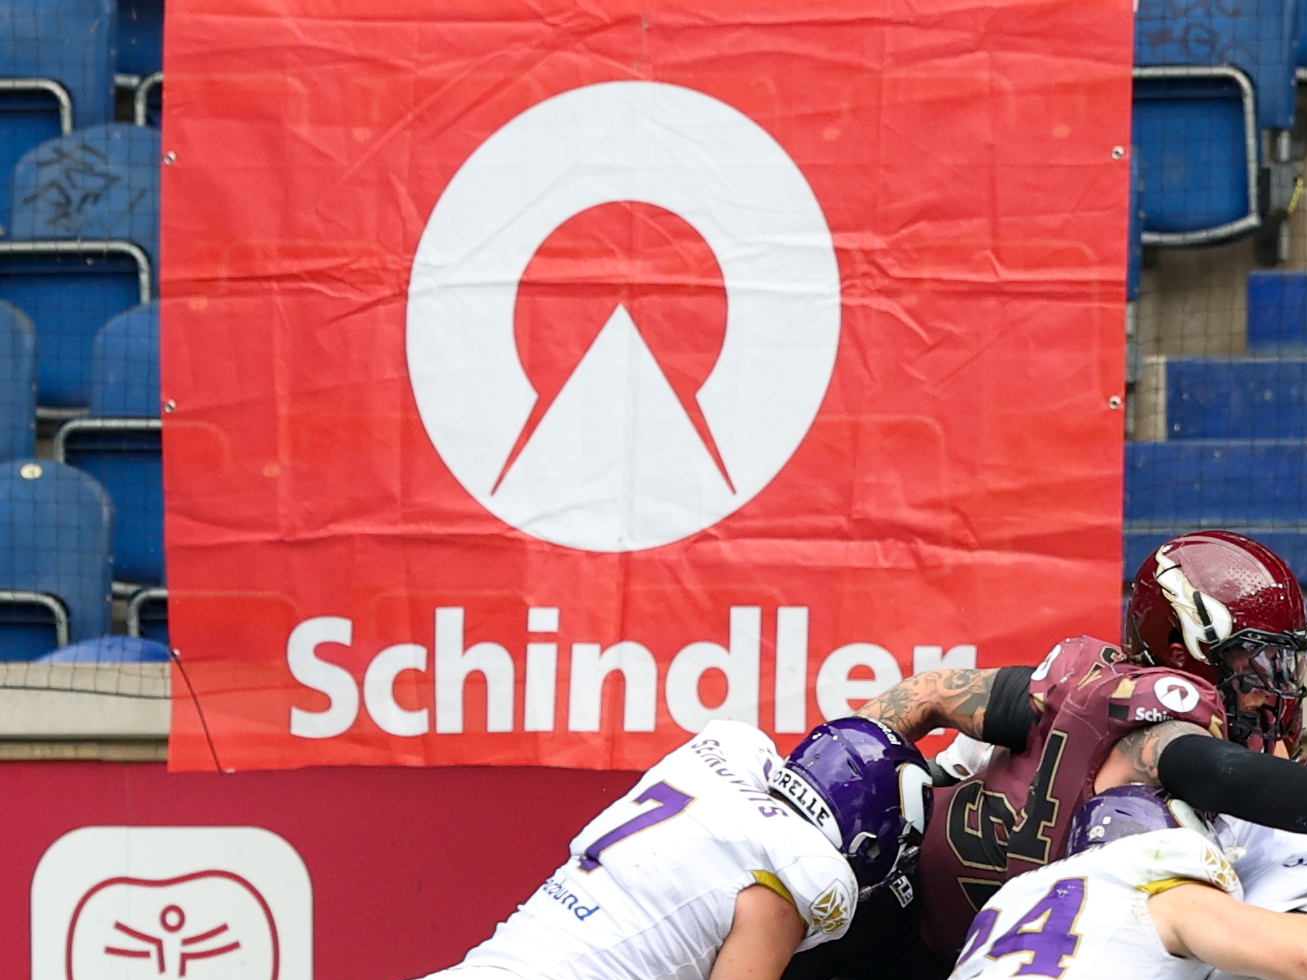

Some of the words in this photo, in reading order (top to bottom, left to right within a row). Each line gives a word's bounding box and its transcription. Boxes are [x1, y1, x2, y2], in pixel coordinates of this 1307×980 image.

[286, 605, 976, 739] Schindler
[578, 779, 698, 875] 7
[772, 768, 831, 828] ORELLE
